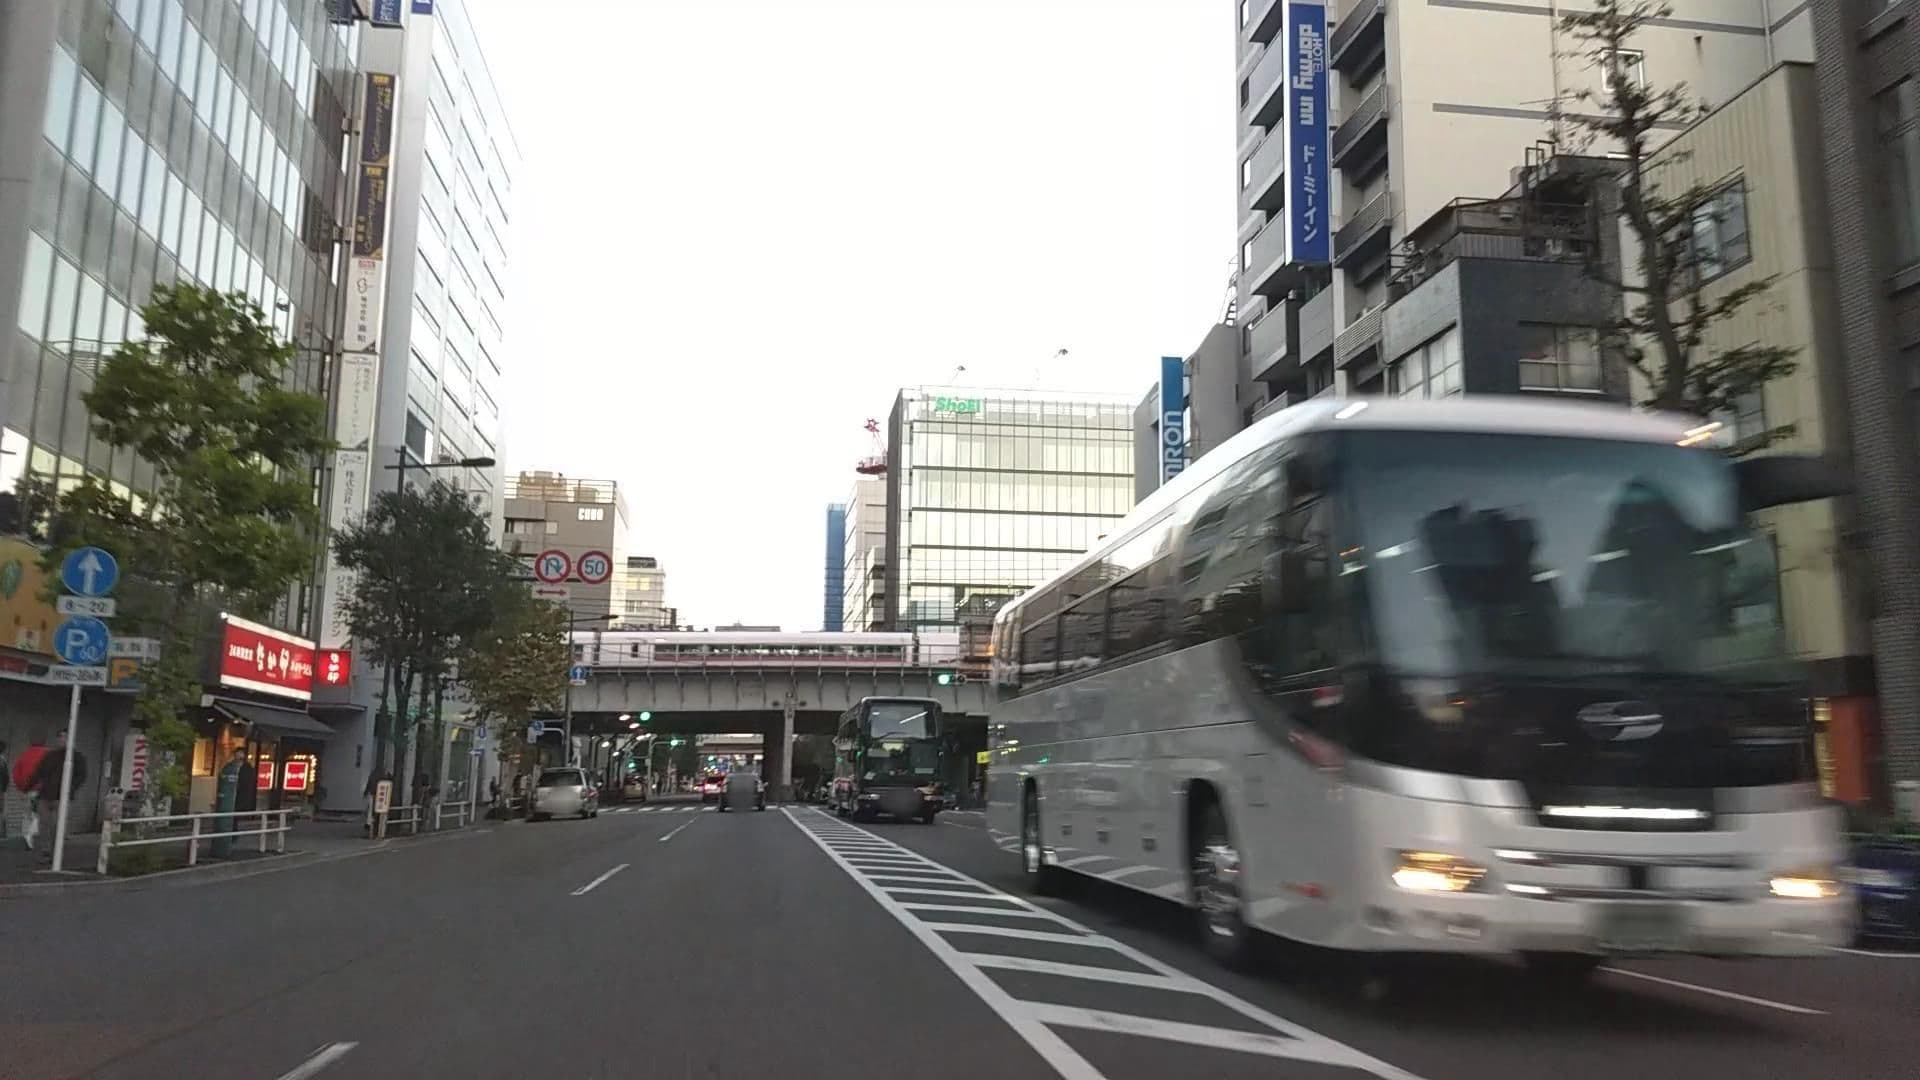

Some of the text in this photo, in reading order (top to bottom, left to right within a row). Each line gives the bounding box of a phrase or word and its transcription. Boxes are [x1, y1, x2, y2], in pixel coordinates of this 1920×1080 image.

[1293, 24, 1319, 89] dormy
[1303, 144, 1318, 243] ドーミーイン
[584, 560, 605, 576] 50
